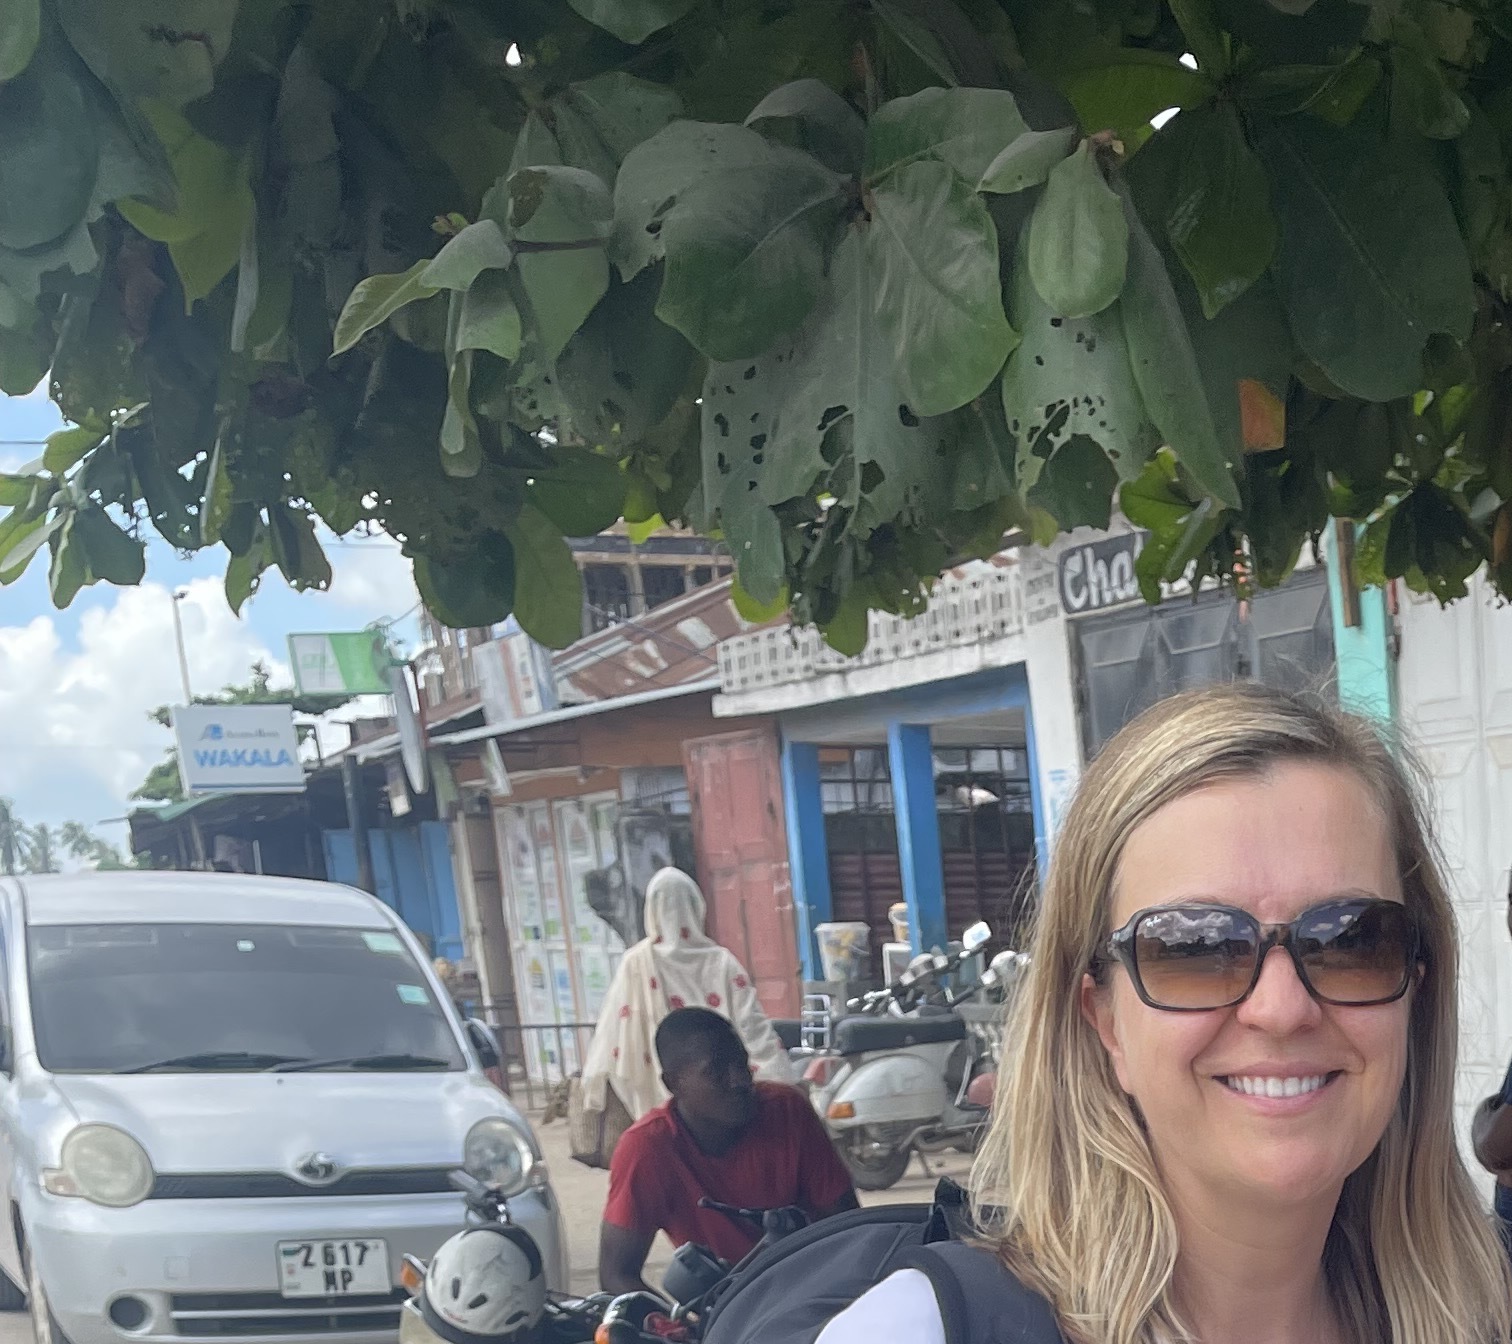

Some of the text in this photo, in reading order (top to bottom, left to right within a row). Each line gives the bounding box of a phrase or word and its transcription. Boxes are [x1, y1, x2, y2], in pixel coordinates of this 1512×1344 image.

[193, 748, 295, 767] WAKALA
[301, 1241, 369, 1267] Z 617
